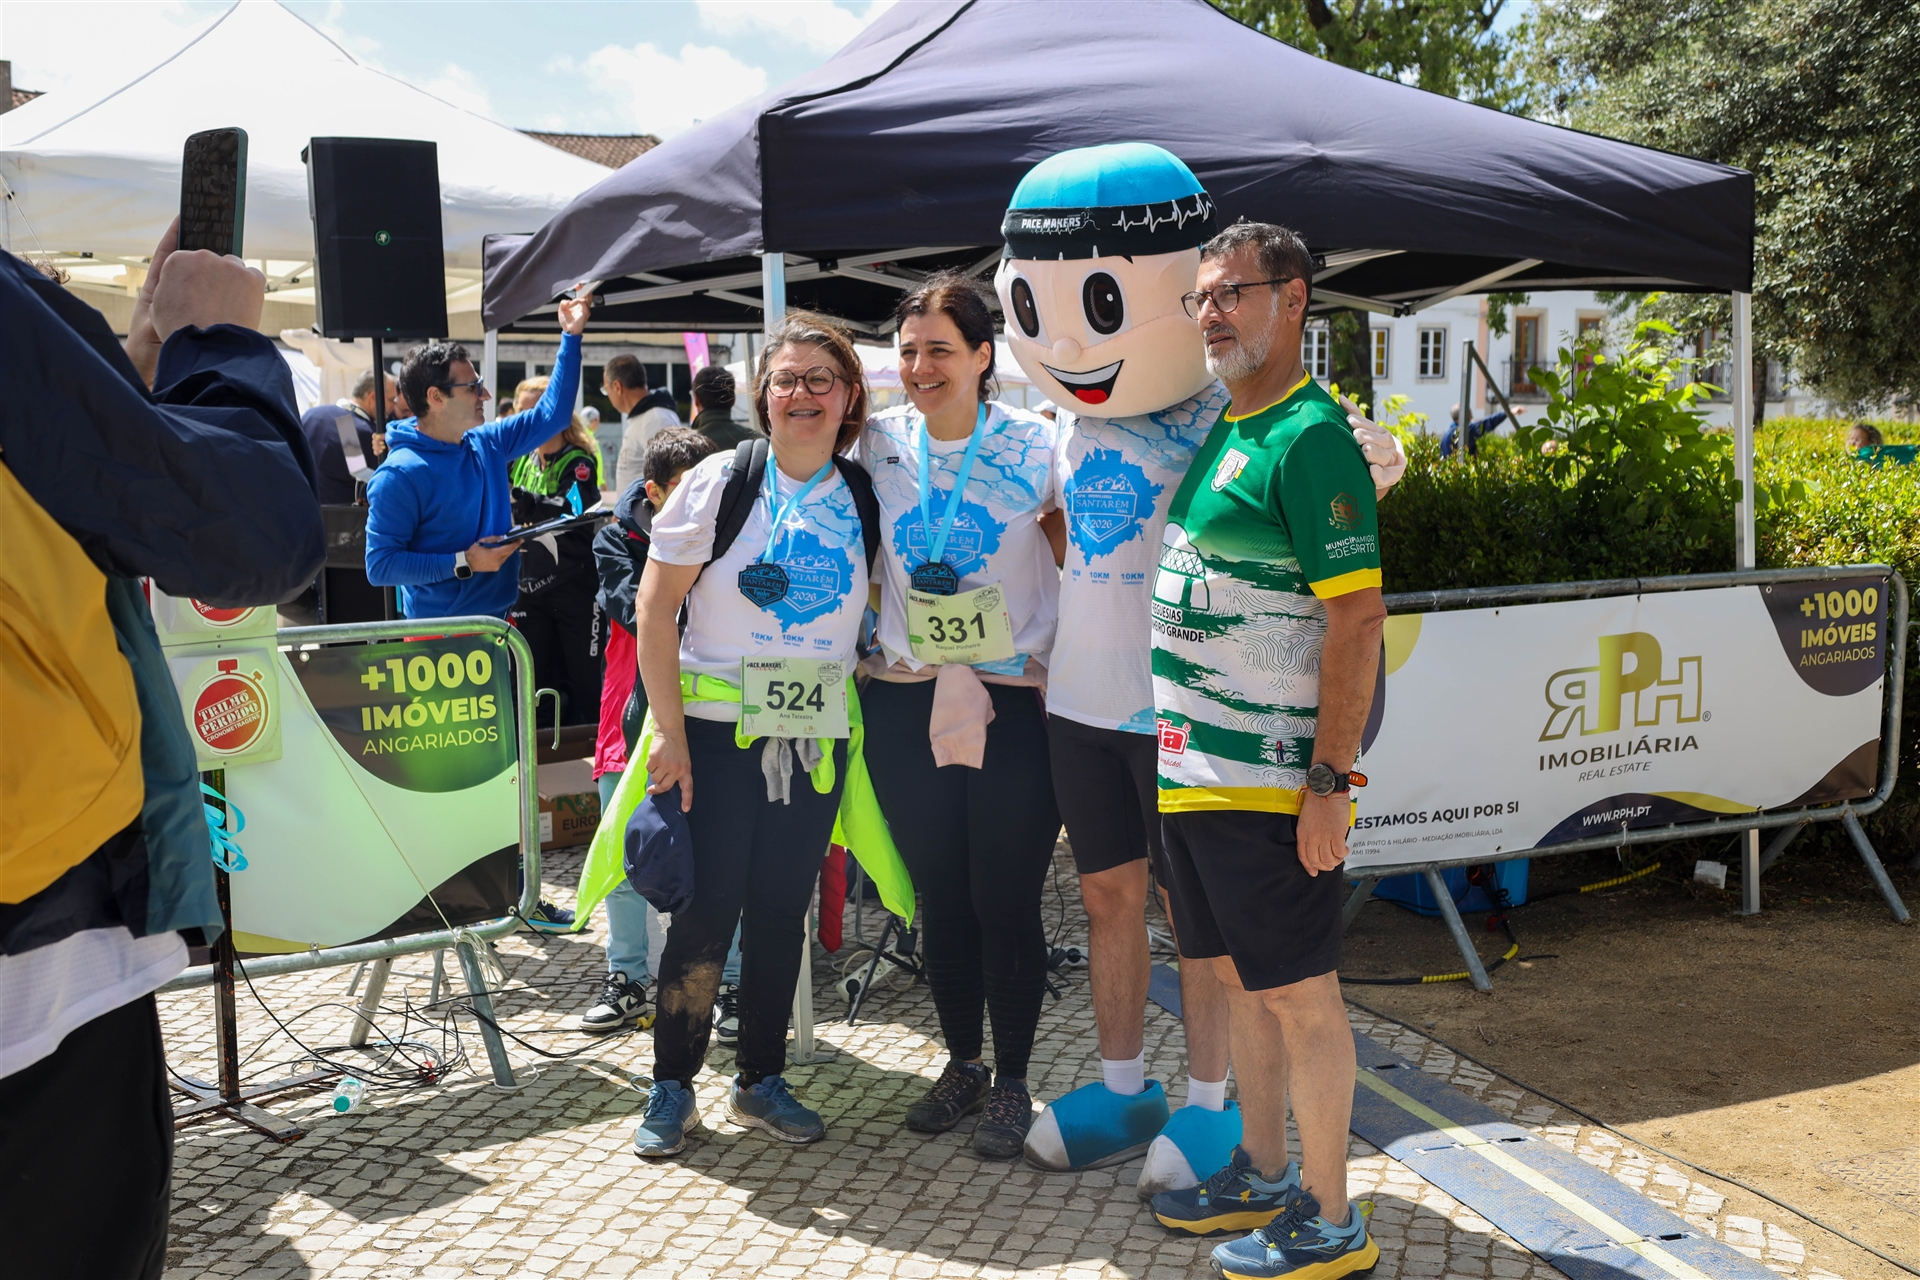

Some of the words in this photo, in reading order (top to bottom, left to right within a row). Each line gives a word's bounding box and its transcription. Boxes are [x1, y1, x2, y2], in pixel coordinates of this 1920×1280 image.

[1021, 219, 1042, 229] PACE
[1043, 217, 1081, 228] MAKERS
[1076, 498, 1129, 509] SANTARÉM
[1091, 519, 1113, 529] 2026
[1090, 572, 1110, 580] 10KM
[792, 591, 817, 602] 2026
[1800, 588, 1878, 620] +1000
[750, 632, 773, 642] 18KM
[928, 612, 986, 643] 331
[1167, 626, 1204, 643] GRANDE
[1801, 622, 1877, 649] IMÓVEIS
[782, 634, 805, 643] 10KM
[814, 638, 832, 646] 10KM
[1800, 646, 1876, 667] ANGARIADOS
[361, 650, 492, 693] +1000
[198, 692, 250, 721] TRILHO
[766, 681, 825, 712] 524
[200, 703, 259, 736] PERDIDO
[362, 696, 497, 731] IMÓVEIS
[206, 714, 260, 743] CRONOMETRAGENS
[363, 726, 499, 755] ANGARIADOS
[1540, 735, 1699, 771] IMOBILIÁRIA
[1578, 768, 1606, 782] REAL
[1609, 761, 1652, 777] ESTATE
[1354, 811, 1428, 830] ESTAMOS
[1431, 807, 1469, 824] AQUI
[1473, 803, 1503, 818] POR
[1507, 801, 1519, 814] SI
[1583, 806, 1652, 826] WWW.RPH.PT
[1367, 839, 1386, 847] PINTO
[1393, 836, 1417, 845] HILÁRIO
[1422, 832, 1453, 843] MEDIAÇÃO
[1454, 829, 1491, 840] IMOBILIÁRIA,
